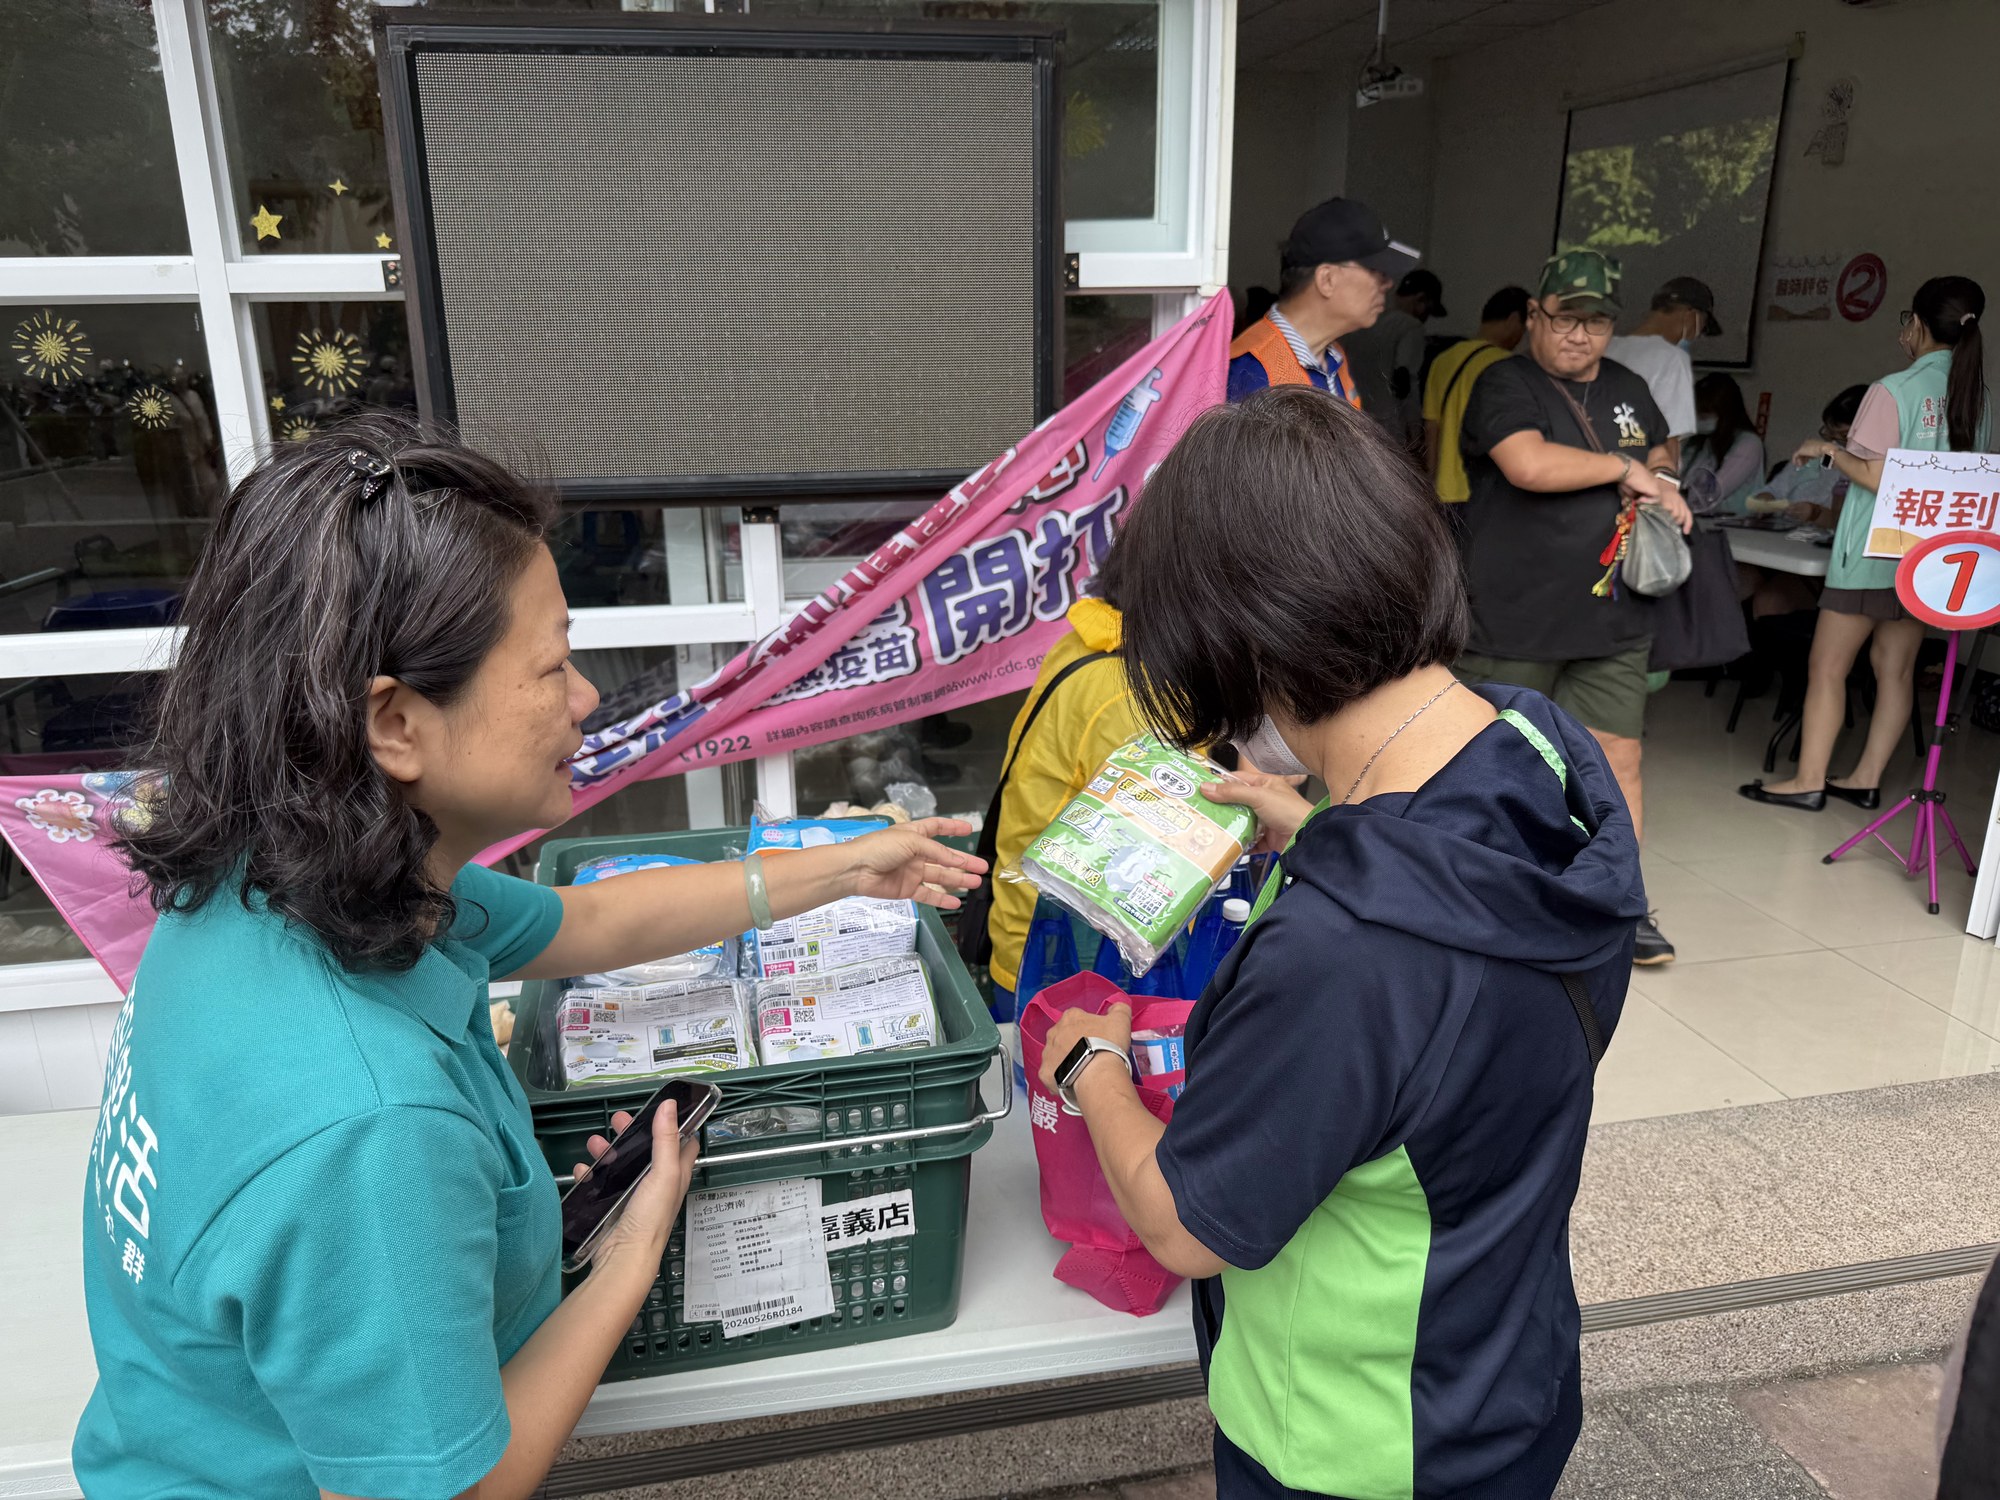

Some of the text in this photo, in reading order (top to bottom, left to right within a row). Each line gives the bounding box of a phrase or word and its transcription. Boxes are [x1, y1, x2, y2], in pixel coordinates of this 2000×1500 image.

[1844, 264, 1877, 309] 2
[1893, 487, 2000, 531] 報到
[1942, 550, 1980, 612] 1
[723, 1305, 804, 1330] 20240526B0184
